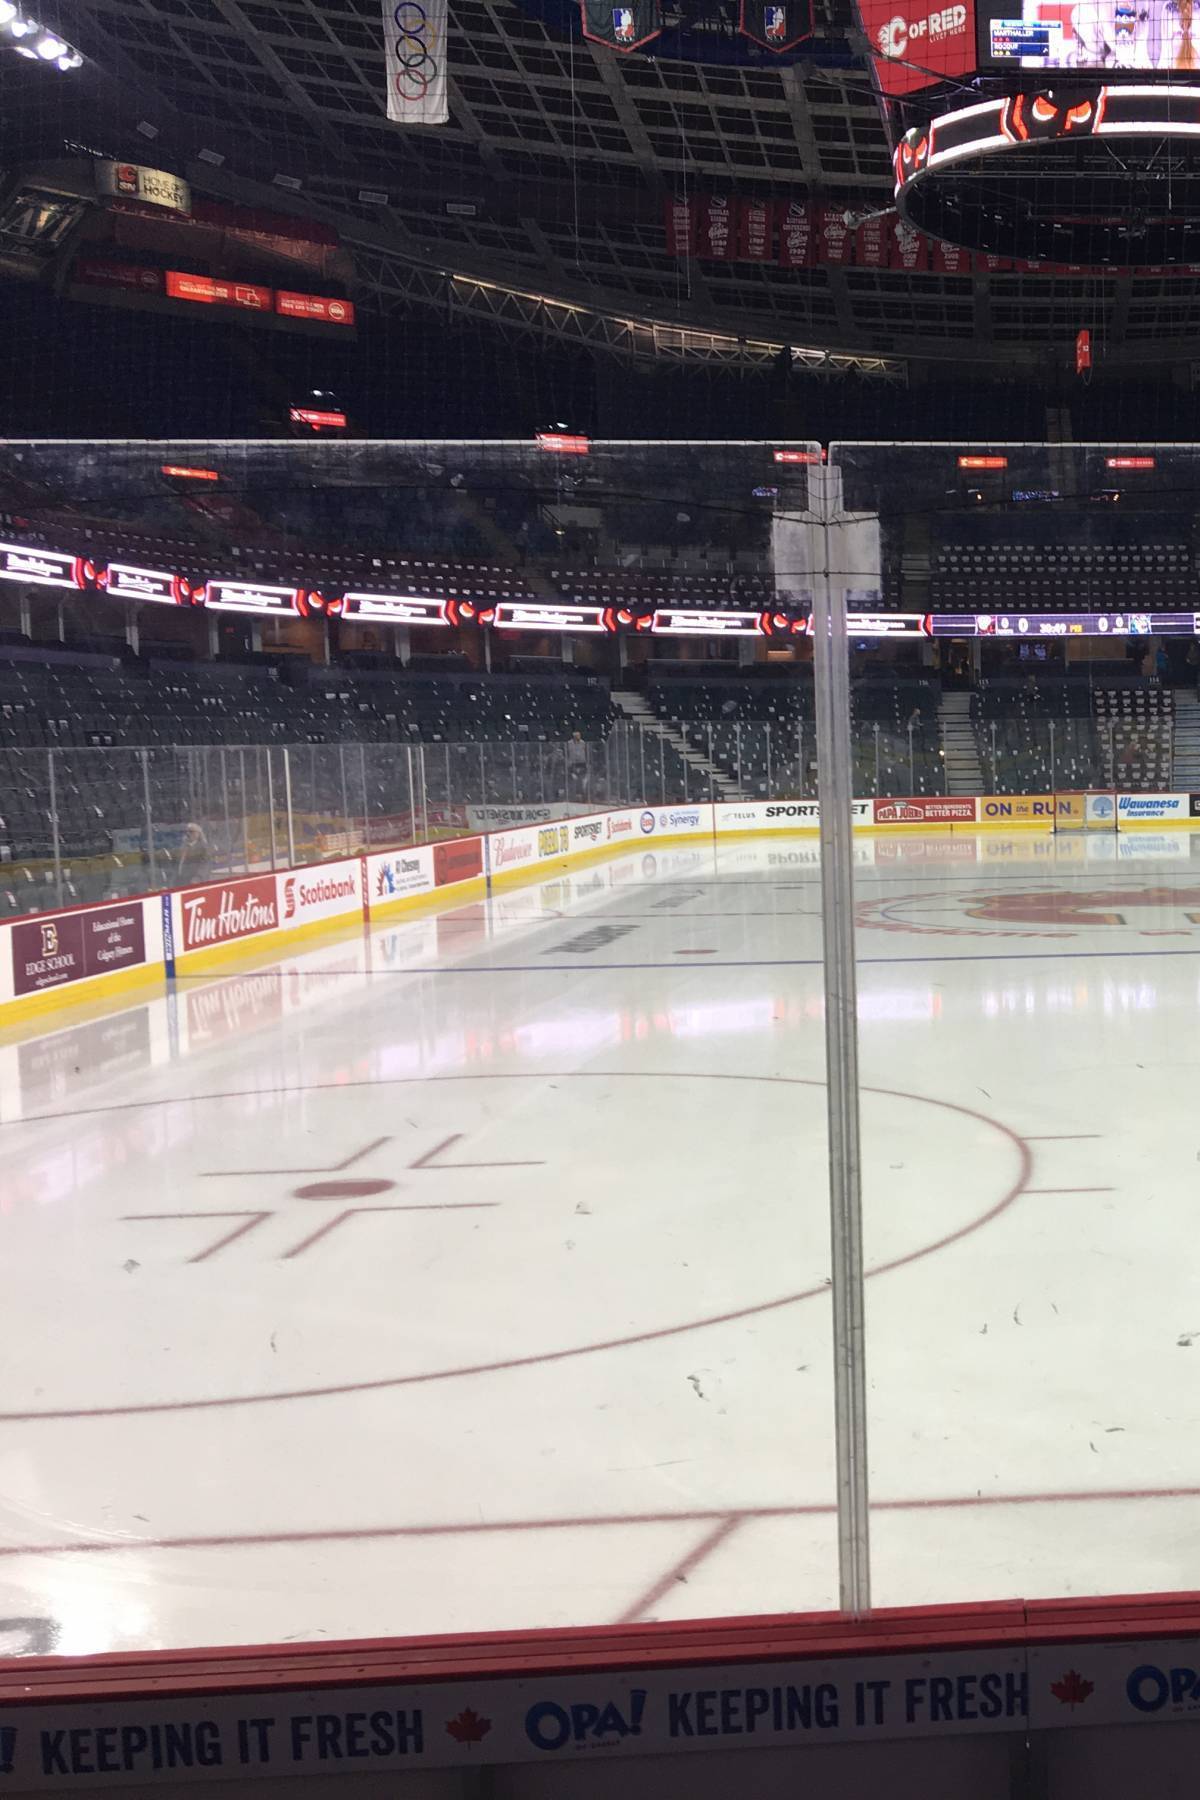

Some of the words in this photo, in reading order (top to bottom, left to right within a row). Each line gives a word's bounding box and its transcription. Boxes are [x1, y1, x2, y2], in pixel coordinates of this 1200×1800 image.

[909, 19, 928, 40] OF
[928, 5, 967, 33] RED
[143, 175, 171, 190] HOME
[143, 184, 184, 204] HOCKEY
[925, 809, 951, 817] BETTER
[984, 802, 1012, 816] ON
[1016, 803, 1029, 814] the
[1033, 802, 1071, 815] RUN
[1119, 797, 1179, 810] Wawanesa
[1126, 809, 1165, 818] Insurance
[669, 814, 700, 828] Synergy
[300, 874, 356, 907] Scotiabank
[184, 896, 217, 945] Tim
[218, 890, 276, 937] Hortons
[25, 959, 49, 976] EDGE
[48, 953, 76, 971] SCHOOL
[524, 1689, 648, 1750] OPA!
[667, 1683, 839, 1738] KEEPING
[855, 1681, 891, 1726] IT
[905, 1672, 1029, 1723] FRESH
[40, 1720, 223, 1775] KEEPING
[238, 1718, 276, 1763] IT
[290, 1709, 425, 1760] FRESH
